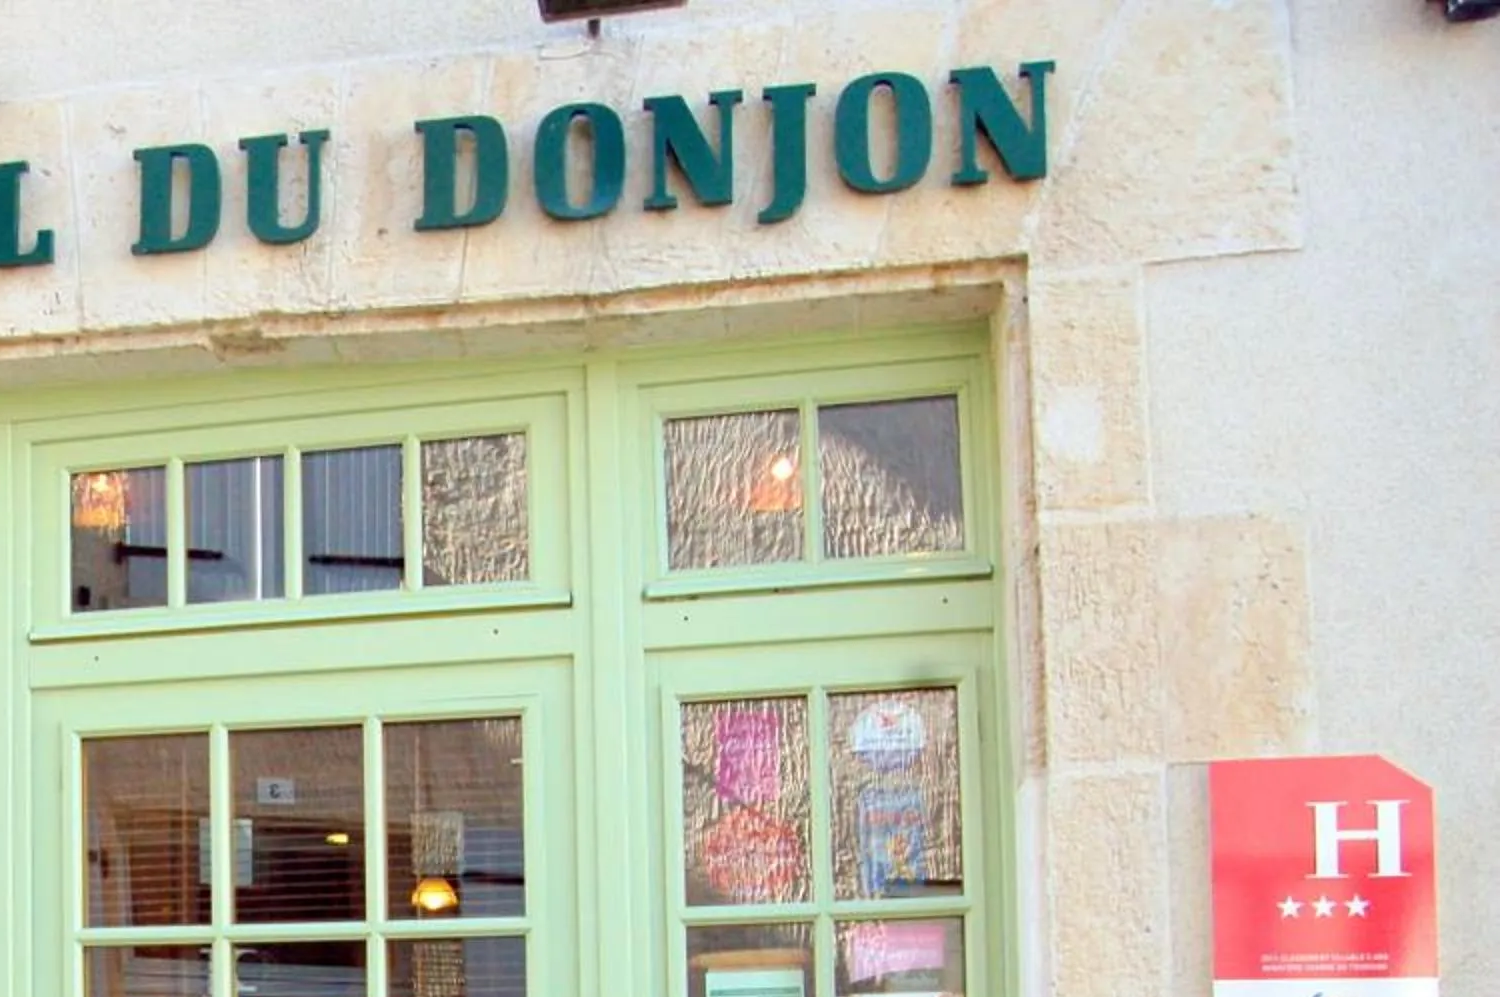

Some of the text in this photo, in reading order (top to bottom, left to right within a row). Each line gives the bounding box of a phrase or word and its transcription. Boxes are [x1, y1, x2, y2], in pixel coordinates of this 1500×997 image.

[131, 129, 329, 255] DU
[414, 60, 1056, 231] DONJON
[1304, 800, 1412, 879] H
